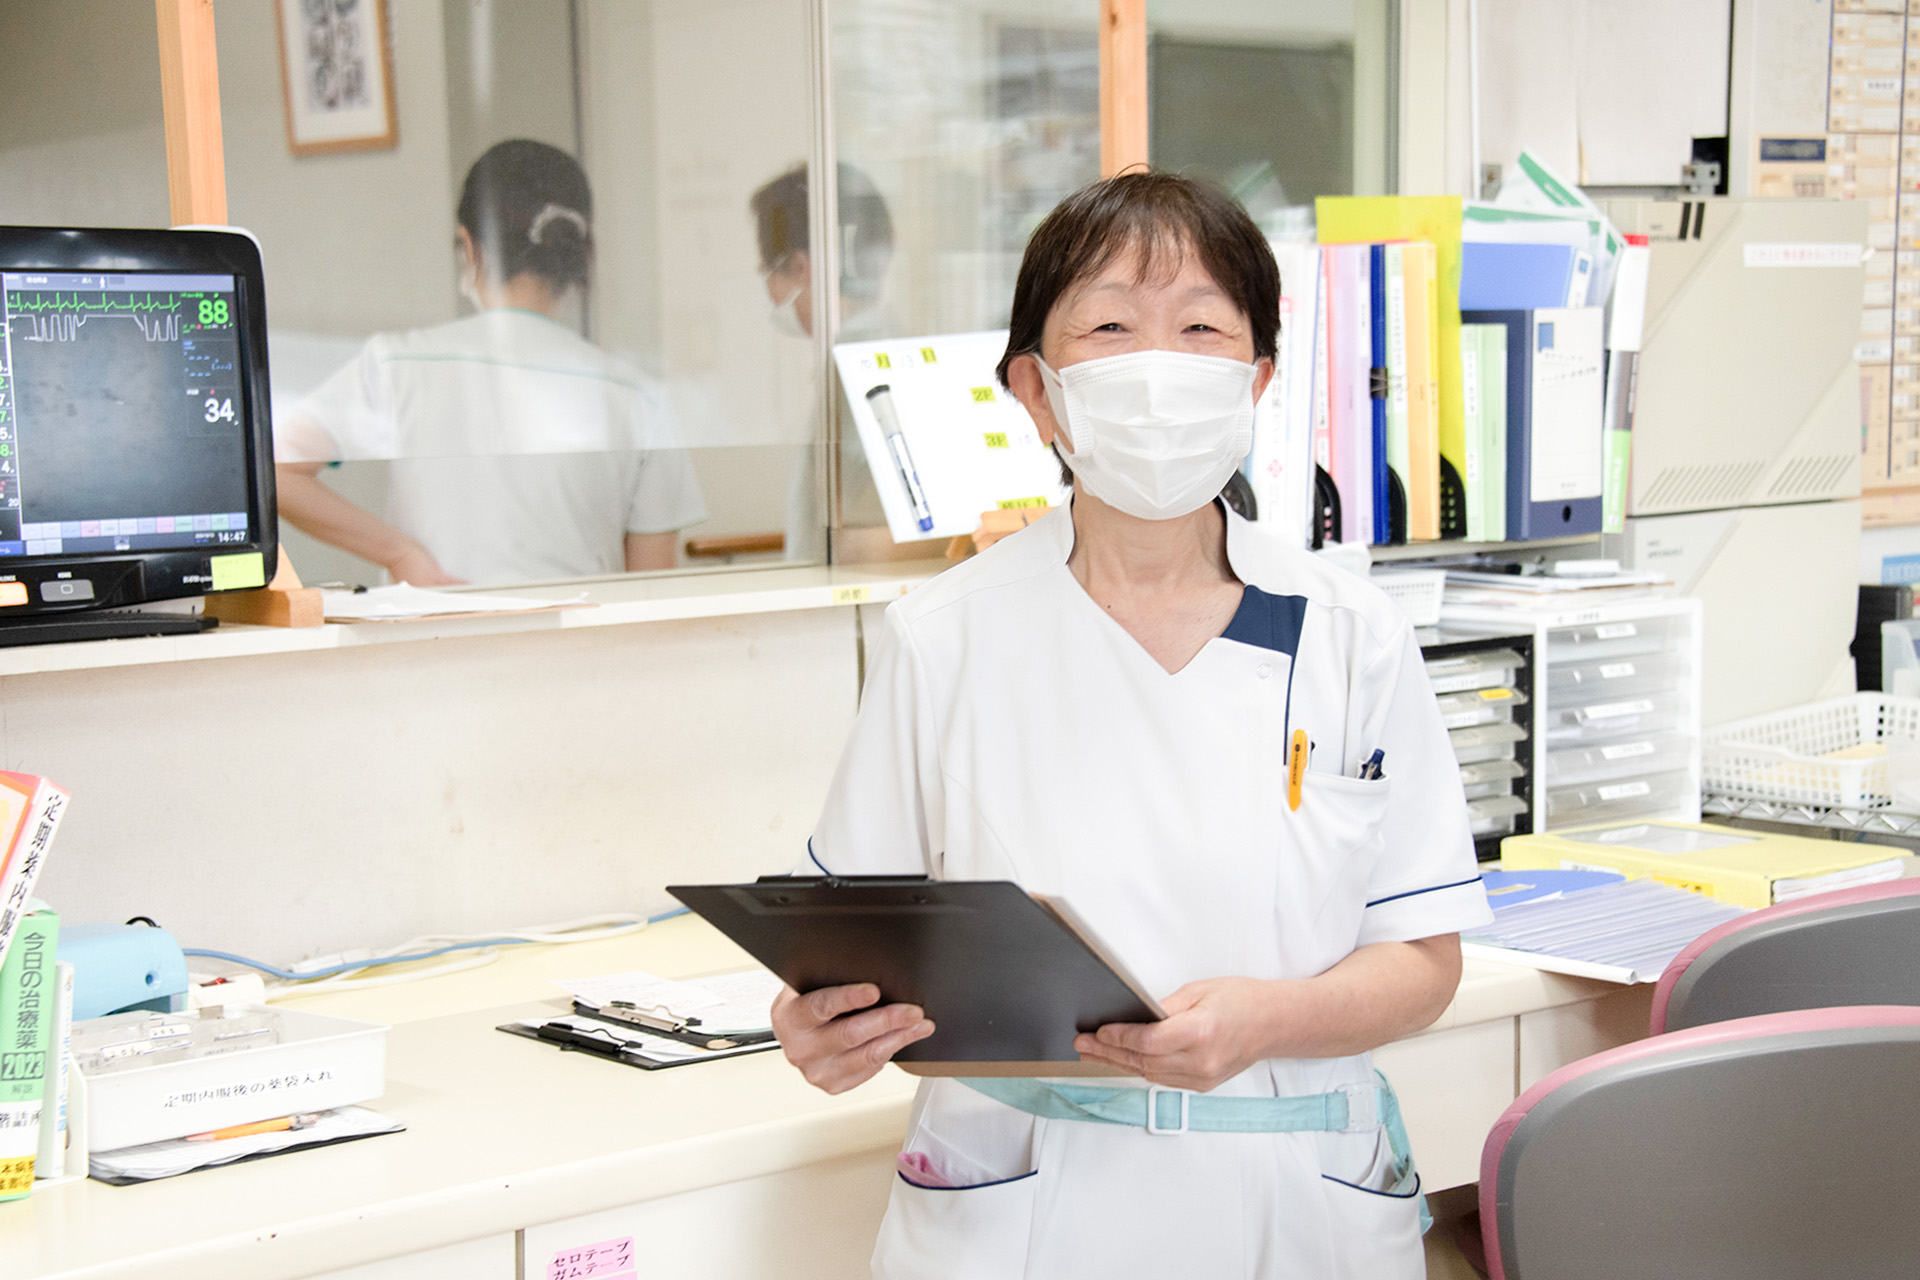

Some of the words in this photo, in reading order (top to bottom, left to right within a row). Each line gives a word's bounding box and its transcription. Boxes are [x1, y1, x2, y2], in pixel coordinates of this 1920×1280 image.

[198, 299, 229, 325] 88
[973, 389, 993, 402] 2F
[204, 398, 234, 423] 34
[986, 435, 1005, 447] 3F
[8, 498, 19, 507] 20
[218, 531, 246, 544] 14:47
[15, 931, 47, 1050] 今日の治療薬
[2, 1052, 46, 1080] 2023
[163, 1071, 333, 1108] 定期内服後の薬袋入れ
[553, 1240, 630, 1267] セロテープ
